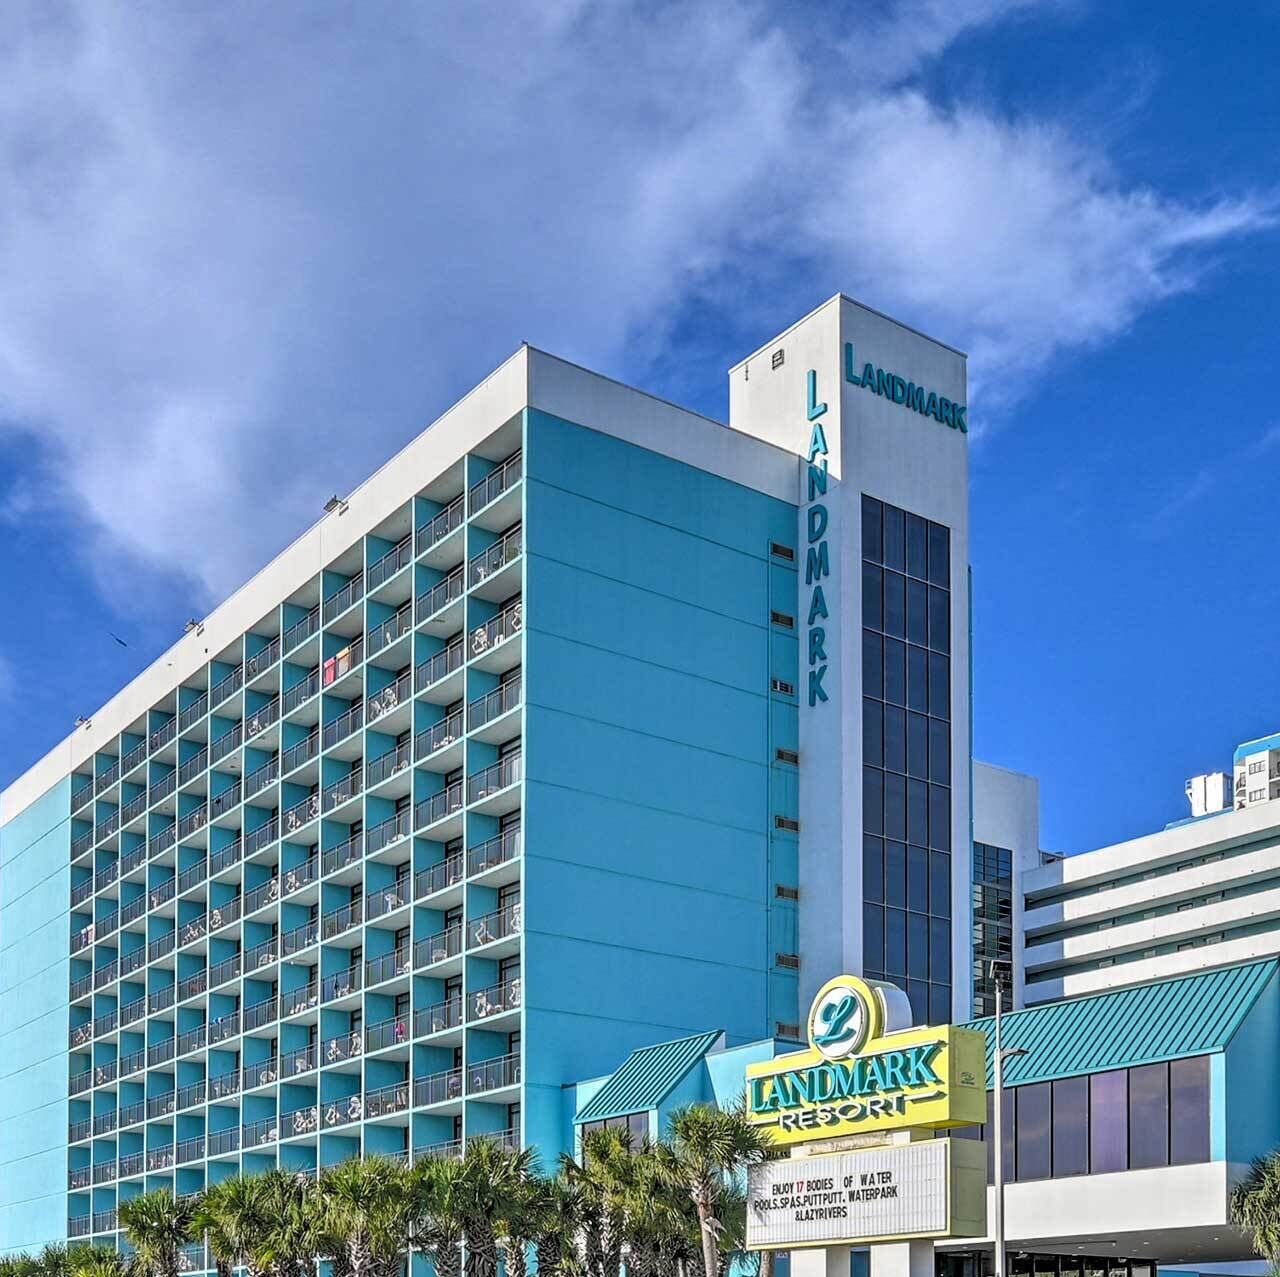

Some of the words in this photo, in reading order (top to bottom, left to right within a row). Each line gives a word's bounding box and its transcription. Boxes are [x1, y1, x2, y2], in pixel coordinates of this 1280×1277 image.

[844, 343, 968, 433] LANDMARK
[805, 369, 829, 708] LANDMARK
[750, 1042, 943, 1113] LANDMARK
[779, 1095, 908, 1131] RESORT
[772, 1182, 794, 1195] ENJOY
[796, 1181, 804, 1192] 17
[806, 1178, 833, 1192] BODIES
[843, 1176, 853, 1188] OF
[860, 1171, 892, 1186] WATER
[848, 1185, 898, 1203] WATERPARK
